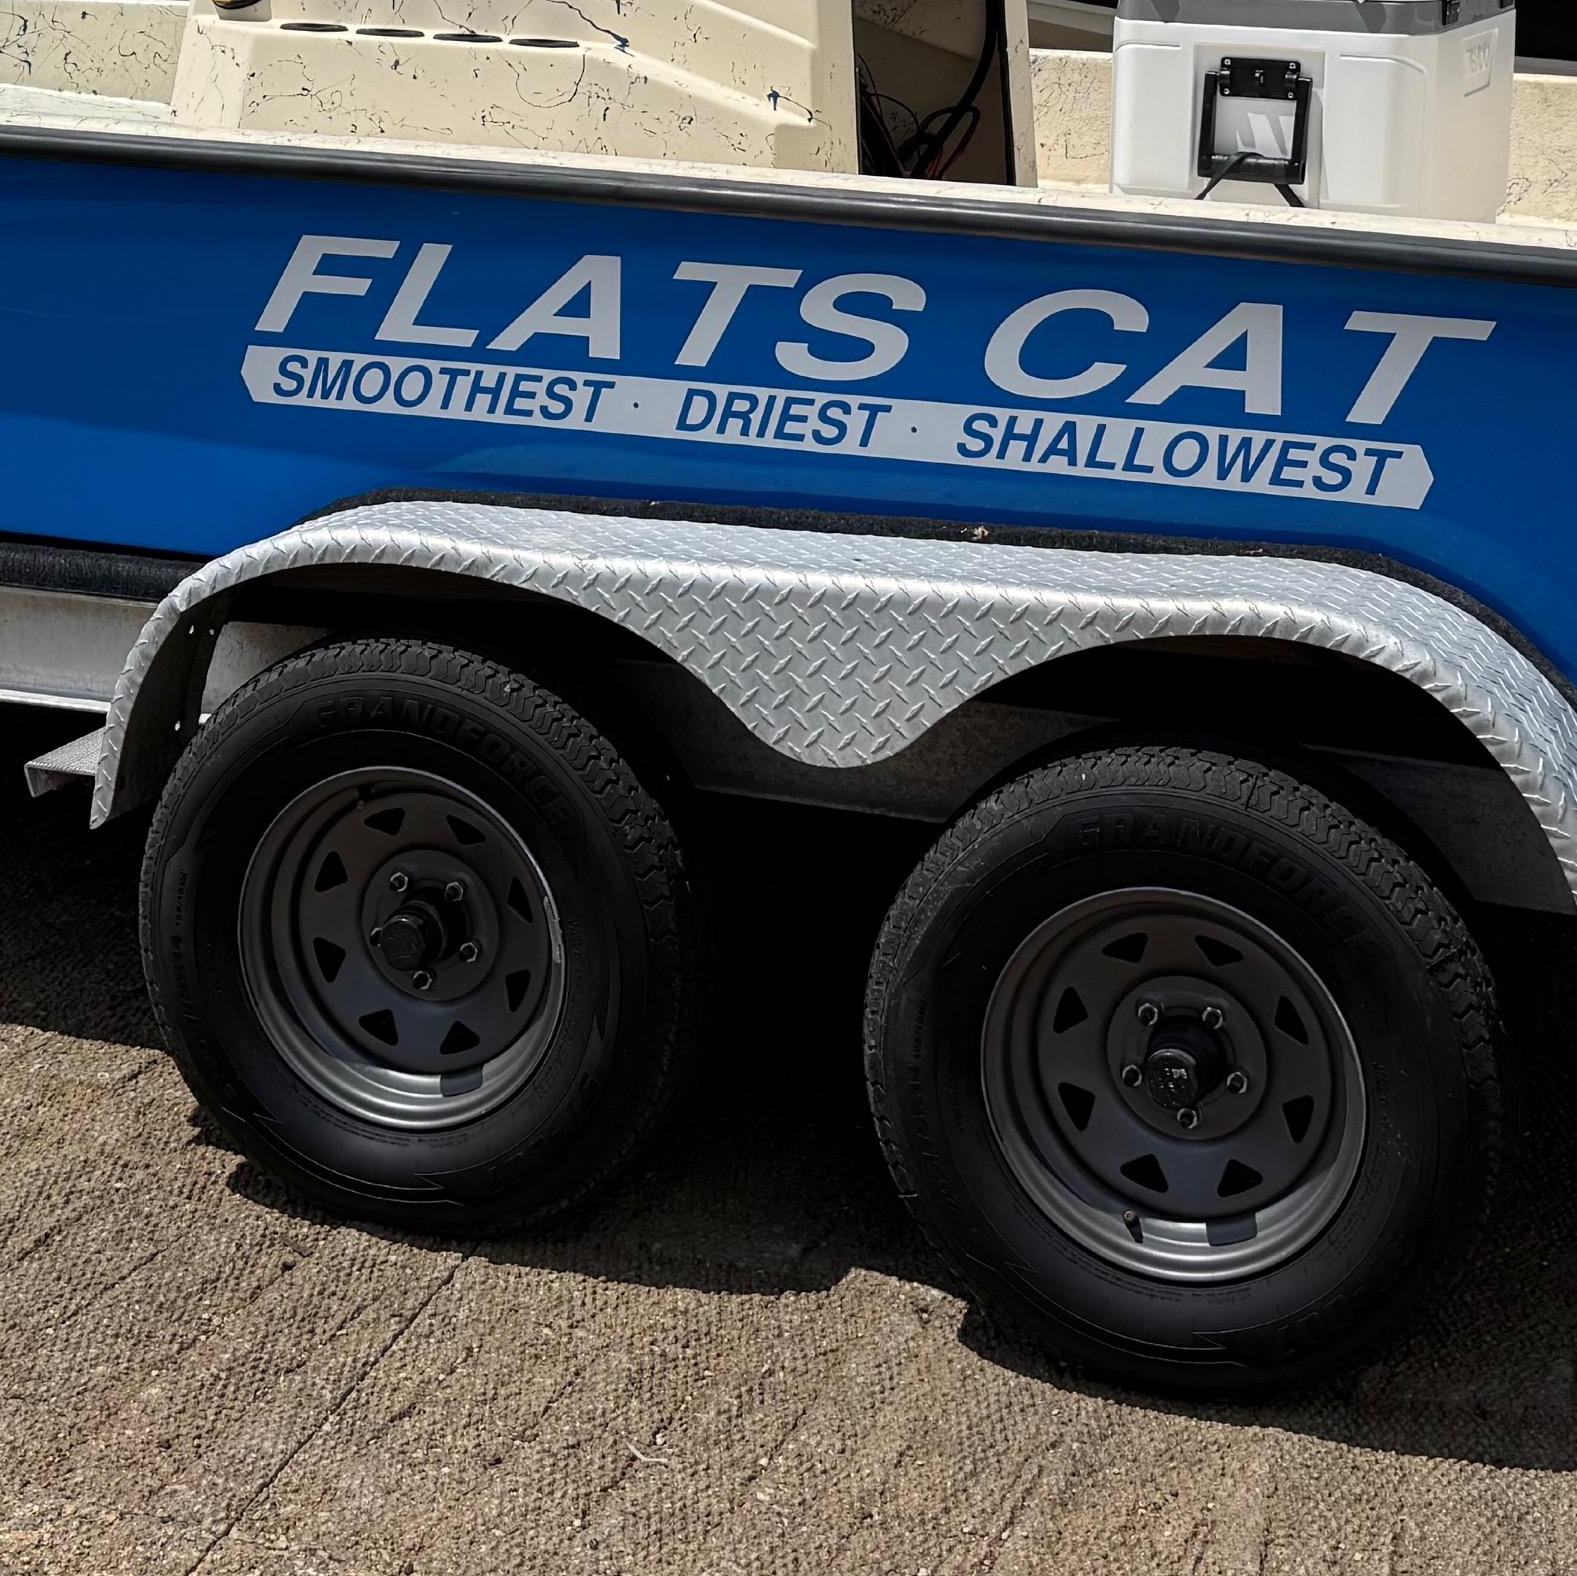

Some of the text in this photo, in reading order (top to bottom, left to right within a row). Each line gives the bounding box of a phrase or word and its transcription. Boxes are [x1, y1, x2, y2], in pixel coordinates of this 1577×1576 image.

[255, 233, 1496, 425] FLATS CAT
[273, 353, 1404, 498] SMOOTHEST DRIEST SHALLOWEST
